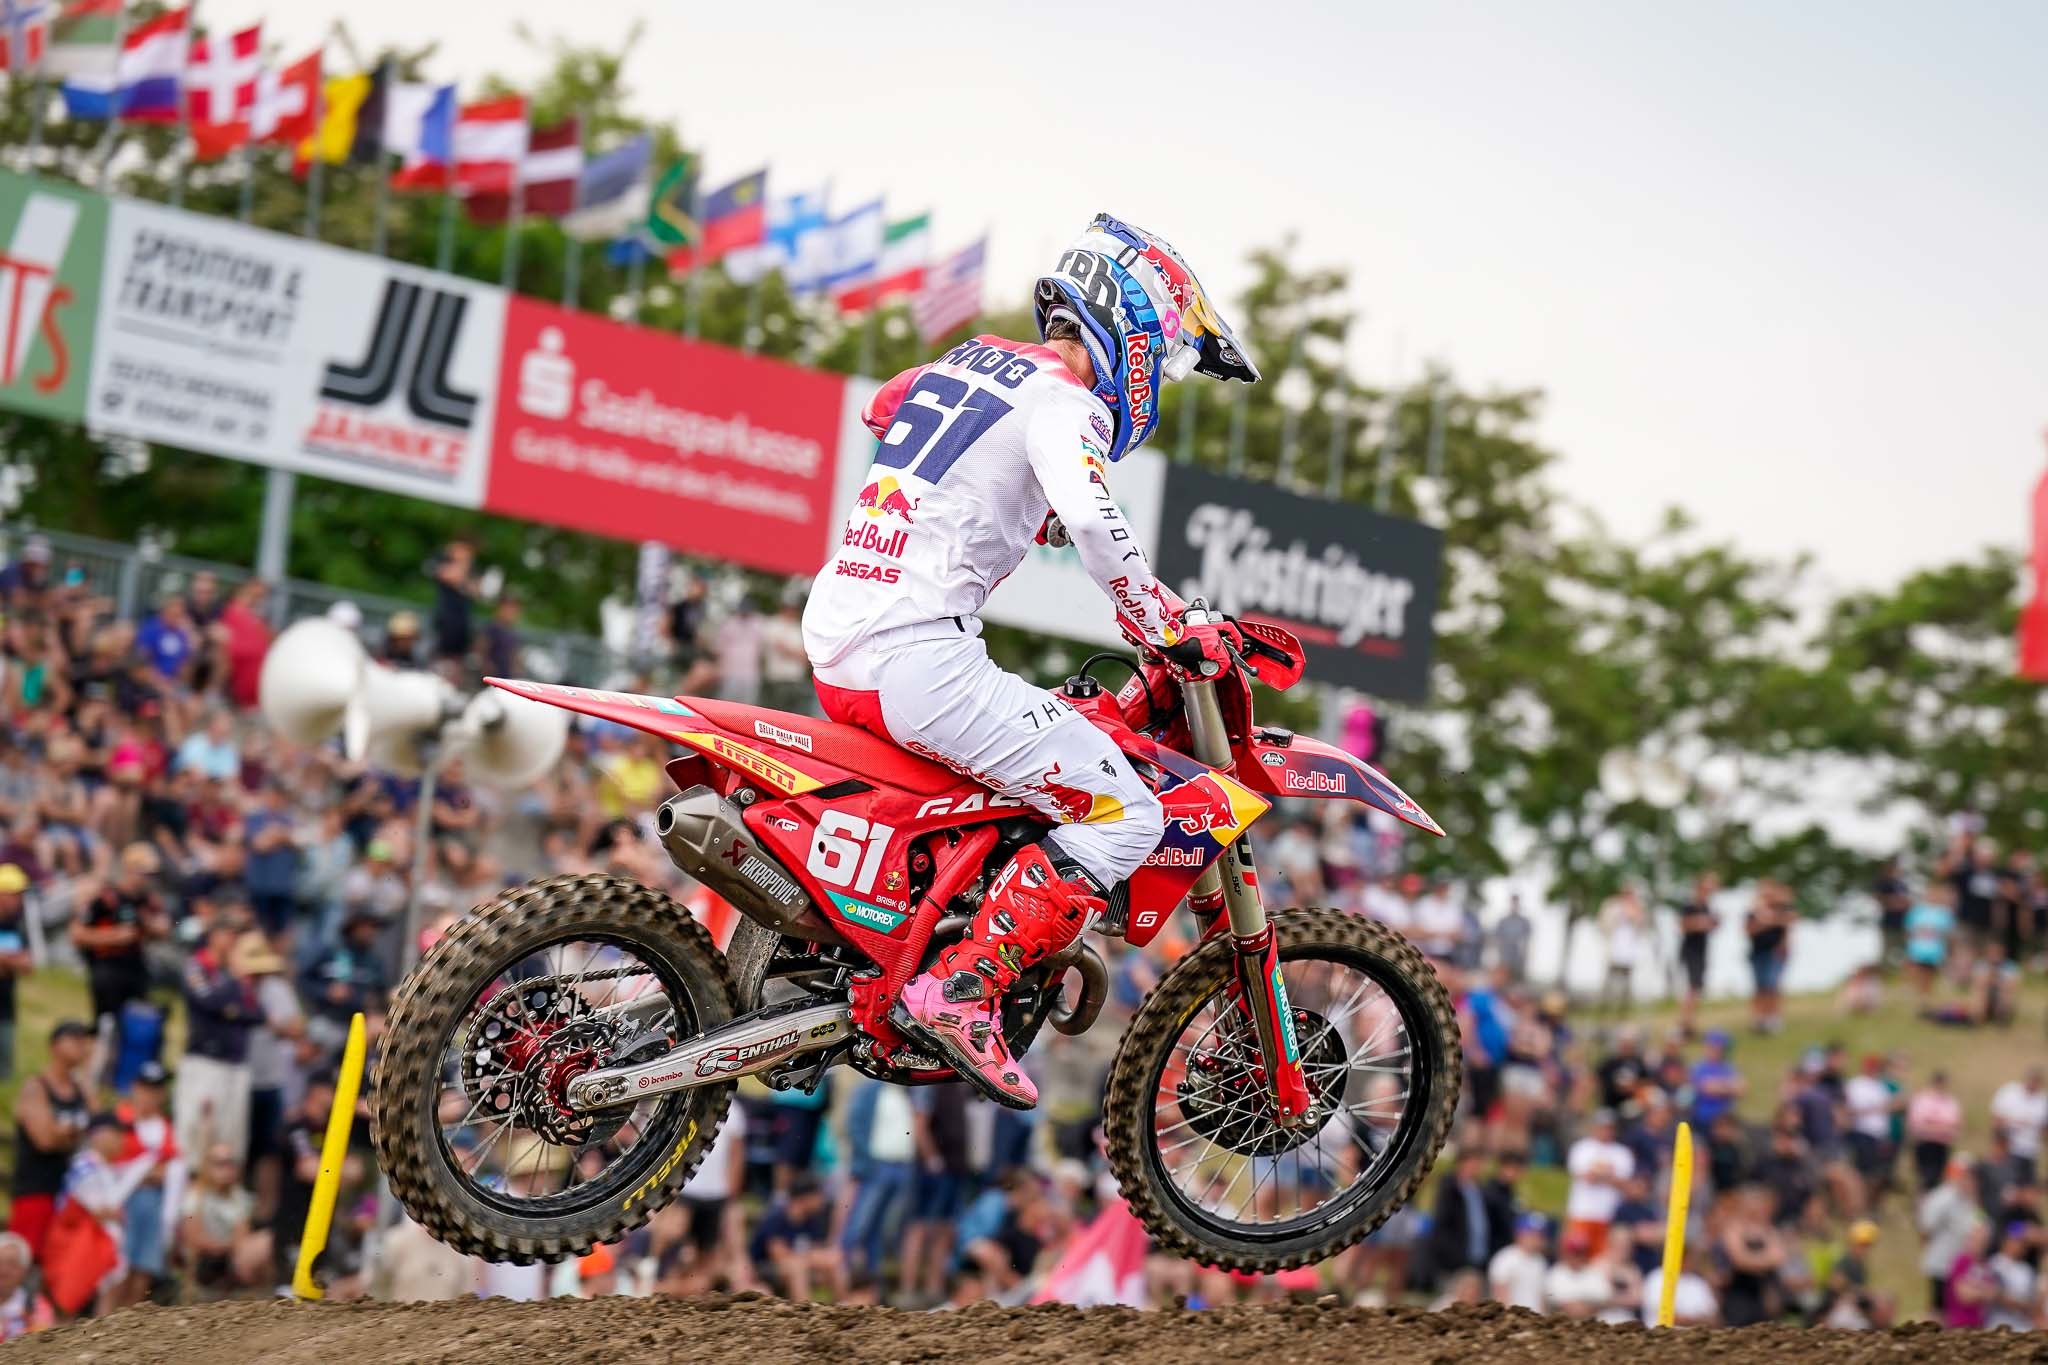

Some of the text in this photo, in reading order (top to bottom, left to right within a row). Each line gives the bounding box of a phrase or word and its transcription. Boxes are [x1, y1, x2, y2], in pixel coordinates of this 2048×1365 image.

[937, 339, 1038, 390] RADO
[1127, 332, 1151, 385] Red
[873, 372, 1015, 486] 61
[862, 523, 909, 559] Bull
[1109, 575, 1142, 611] Red
[713, 738, 796, 792] PIRELLI
[1286, 769, 1346, 794] Red Bull
[806, 808, 896, 895] 61
[1170, 846, 1204, 867] Bull
[856, 904, 896, 927] MOTOREX
[875, 894, 898, 908] BRISK
[1278, 985, 1299, 1056] MOTOREX
[695, 1029, 801, 1078] RENTHAL
[651, 1071, 683, 1085] brembo
